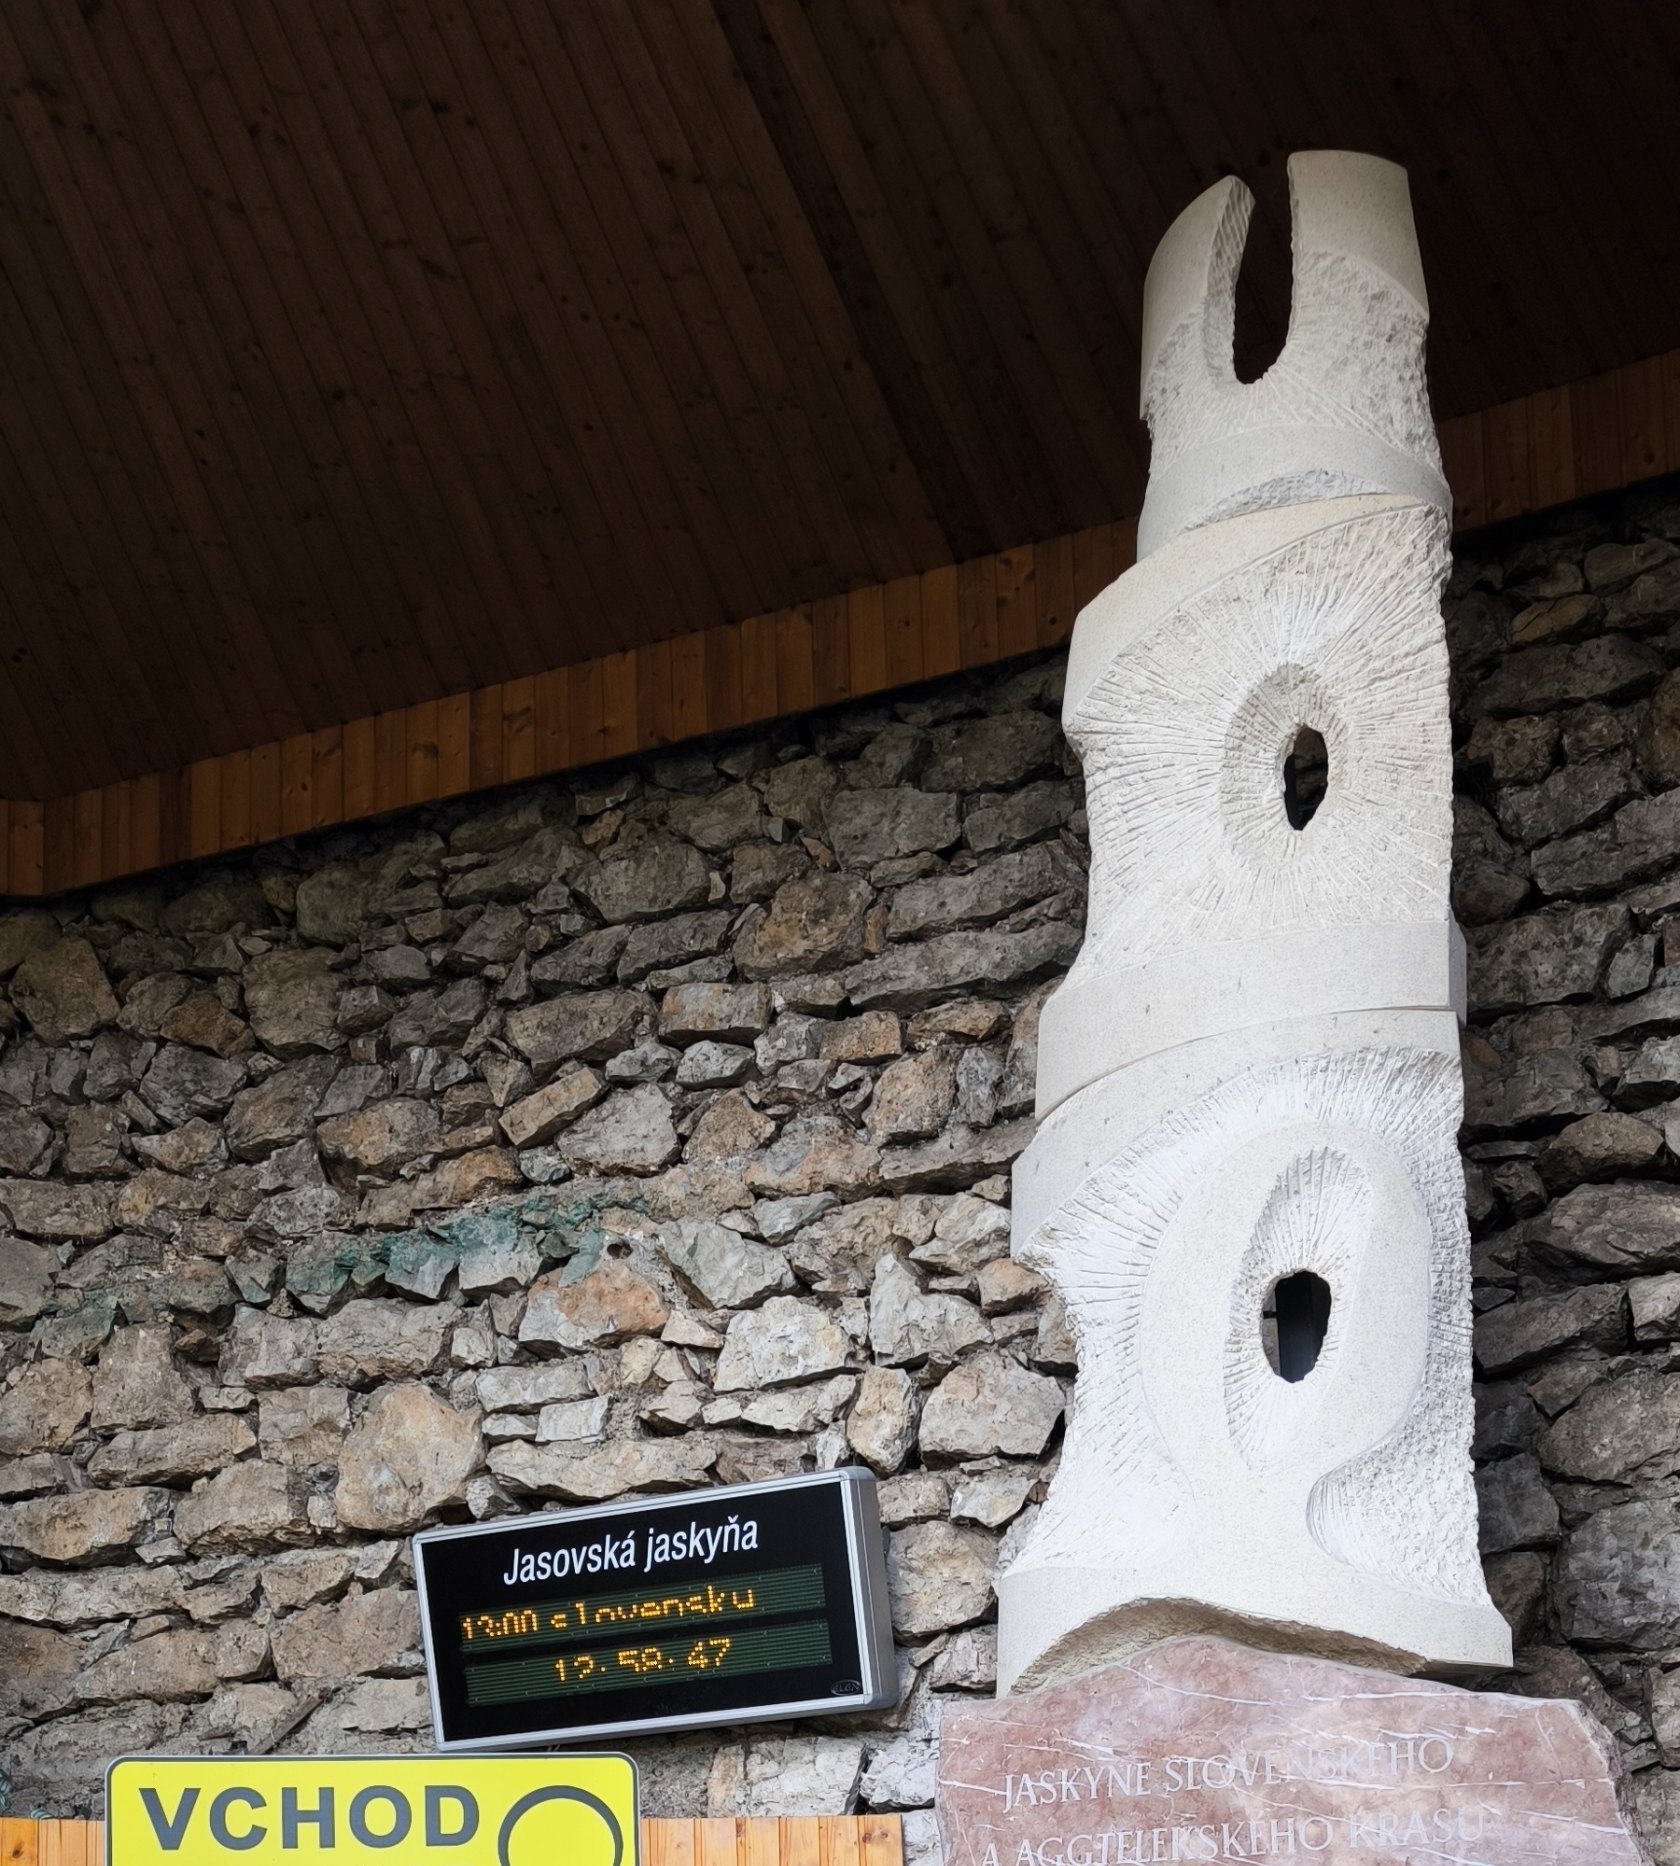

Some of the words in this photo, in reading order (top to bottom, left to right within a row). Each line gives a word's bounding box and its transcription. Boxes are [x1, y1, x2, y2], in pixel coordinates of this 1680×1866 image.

[503, 1530, 636, 1586] Jasovská
[643, 1514, 759, 1573] jaskyňa
[138, 1784, 480, 1851] VCHOD
[1003, 1762, 1151, 1814] JASKYNE
[1350, 1804, 1484, 1849] KRASU
